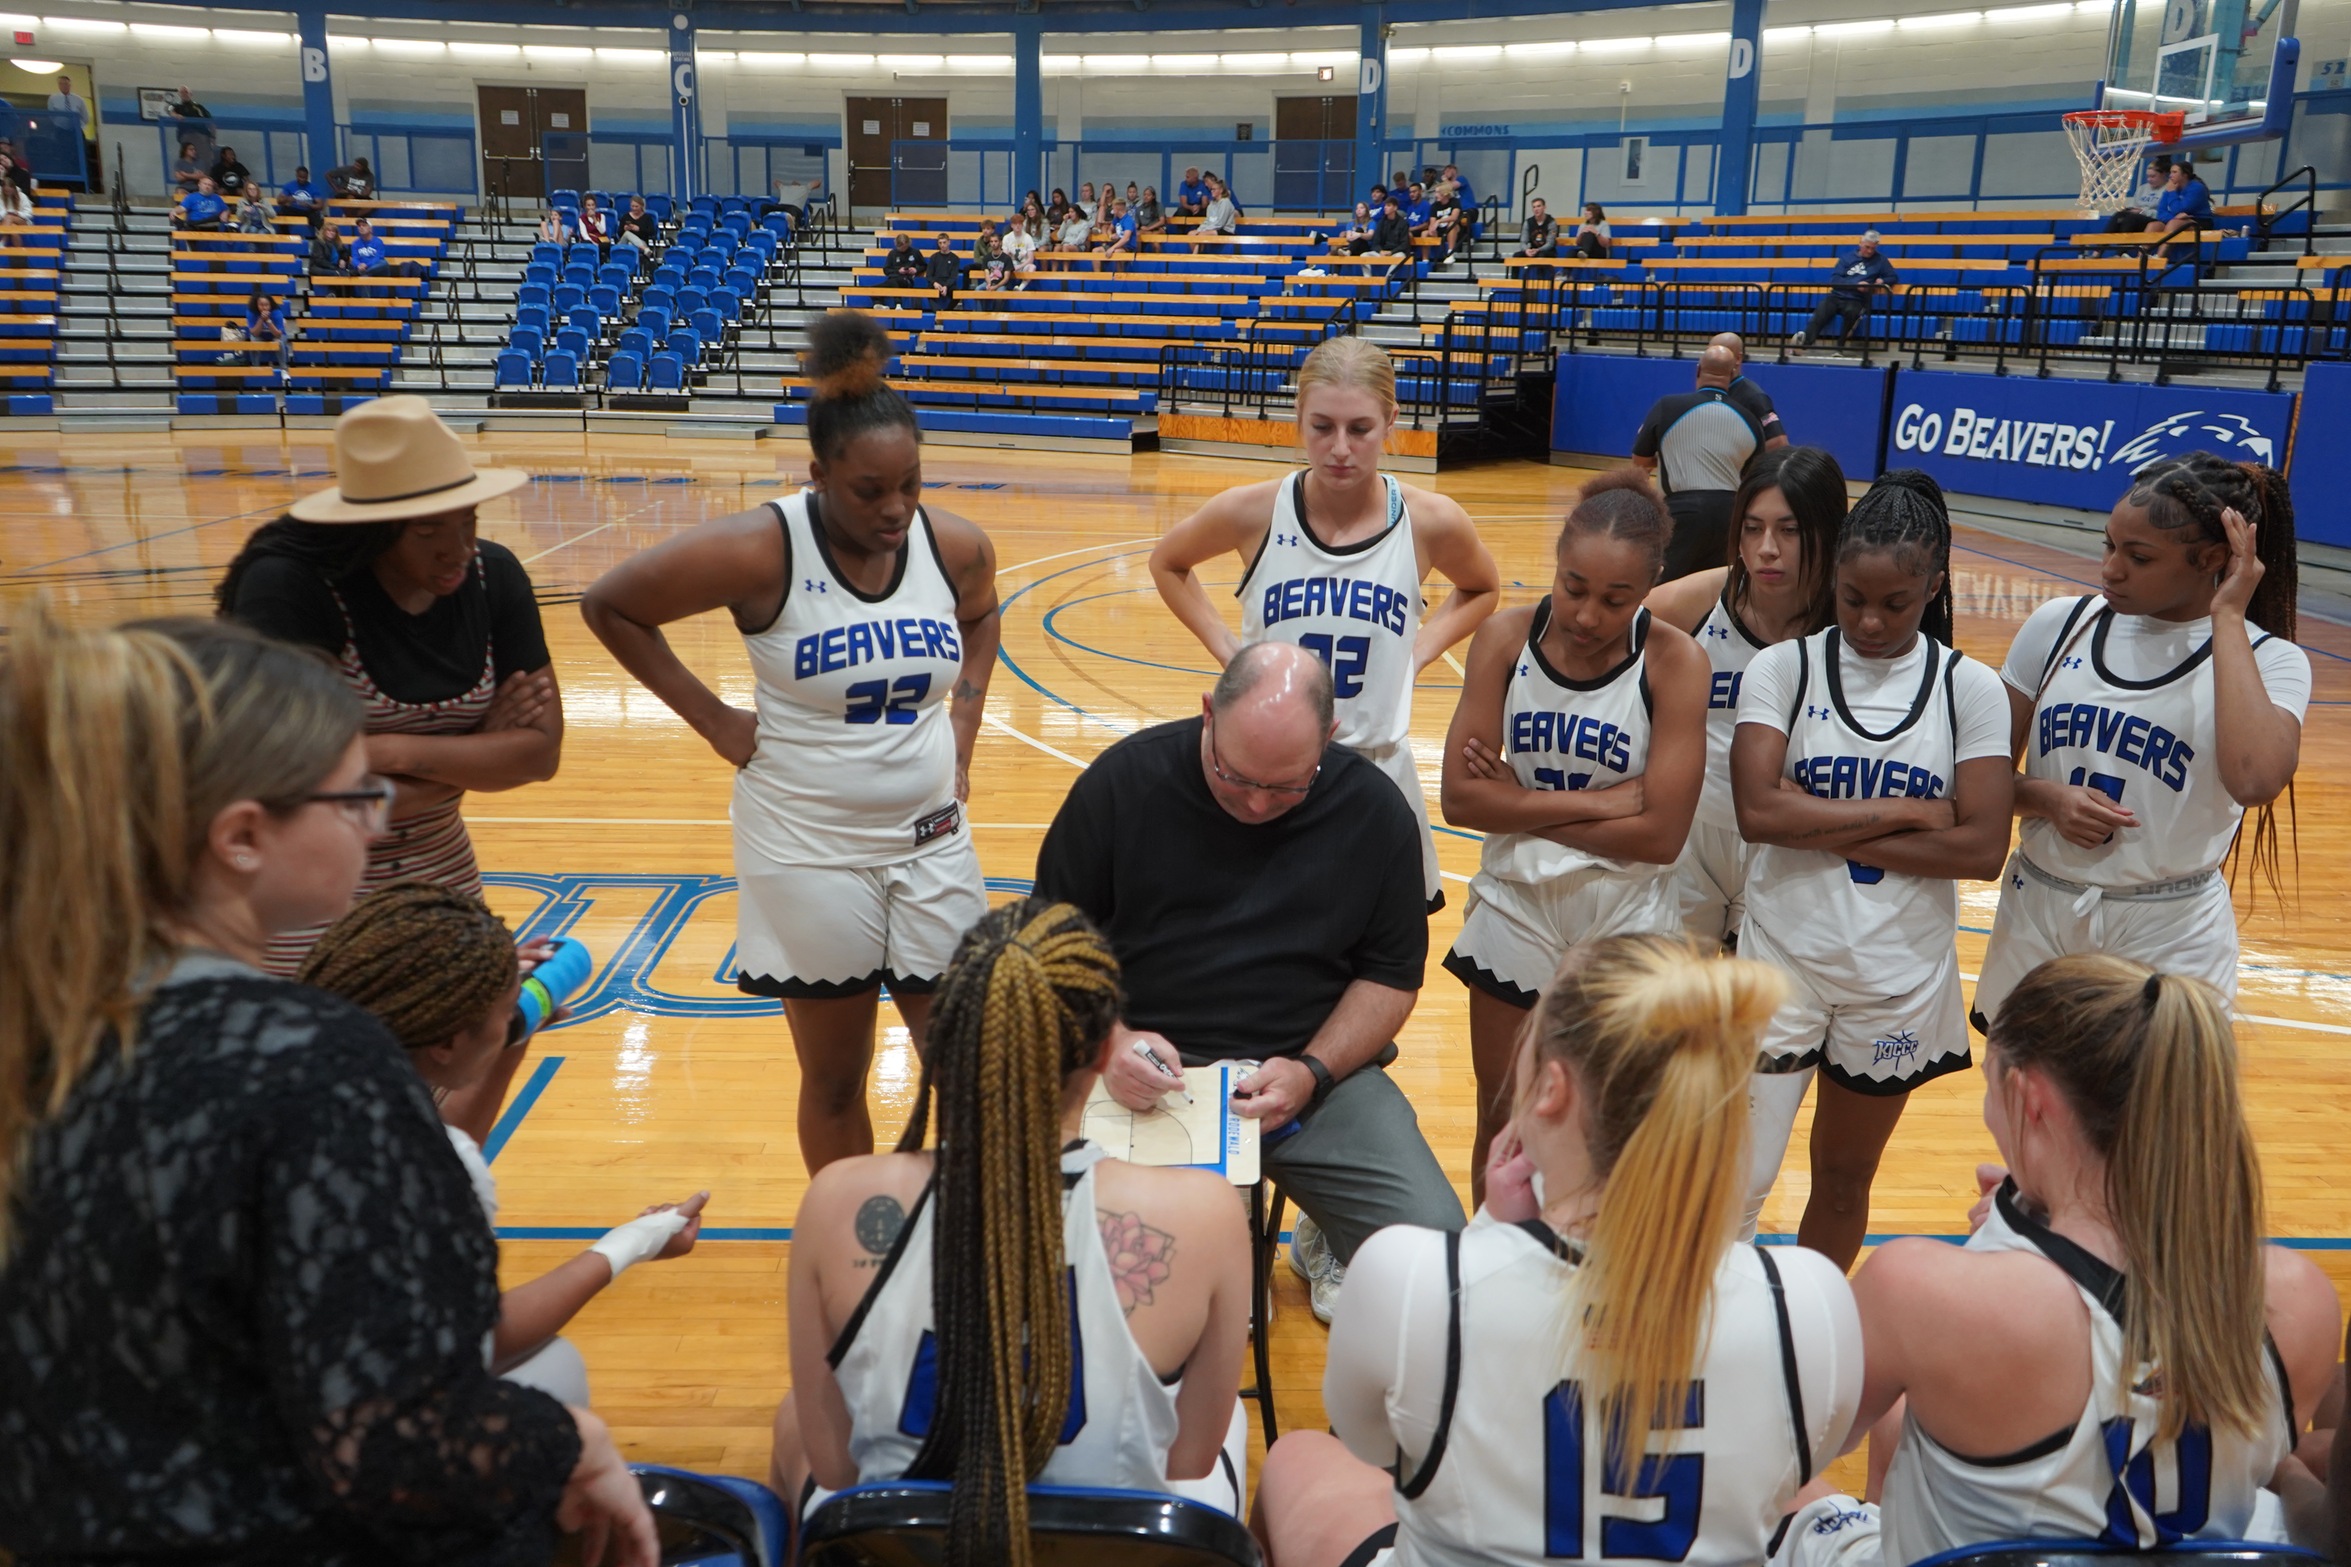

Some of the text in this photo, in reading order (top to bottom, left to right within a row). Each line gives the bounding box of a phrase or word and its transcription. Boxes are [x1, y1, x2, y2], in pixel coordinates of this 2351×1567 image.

[302, 47, 327, 82] B
[674, 63, 693, 97] C
[1361, 58, 1382, 94] D
[1729, 38, 1755, 79] D
[1447, 125, 1508, 136] COMMONS
[1943, 407, 2116, 471] BEAVERS!
[1263, 577, 1408, 637] BEAVERS
[795, 618, 960, 680] BEAVERS
[1510, 711, 1631, 774] EAVERS
[2039, 703, 2195, 793] BEAVERS
[1228, 1117, 1240, 1155] RODEWALD
[1543, 1378, 1704, 1562] 15
